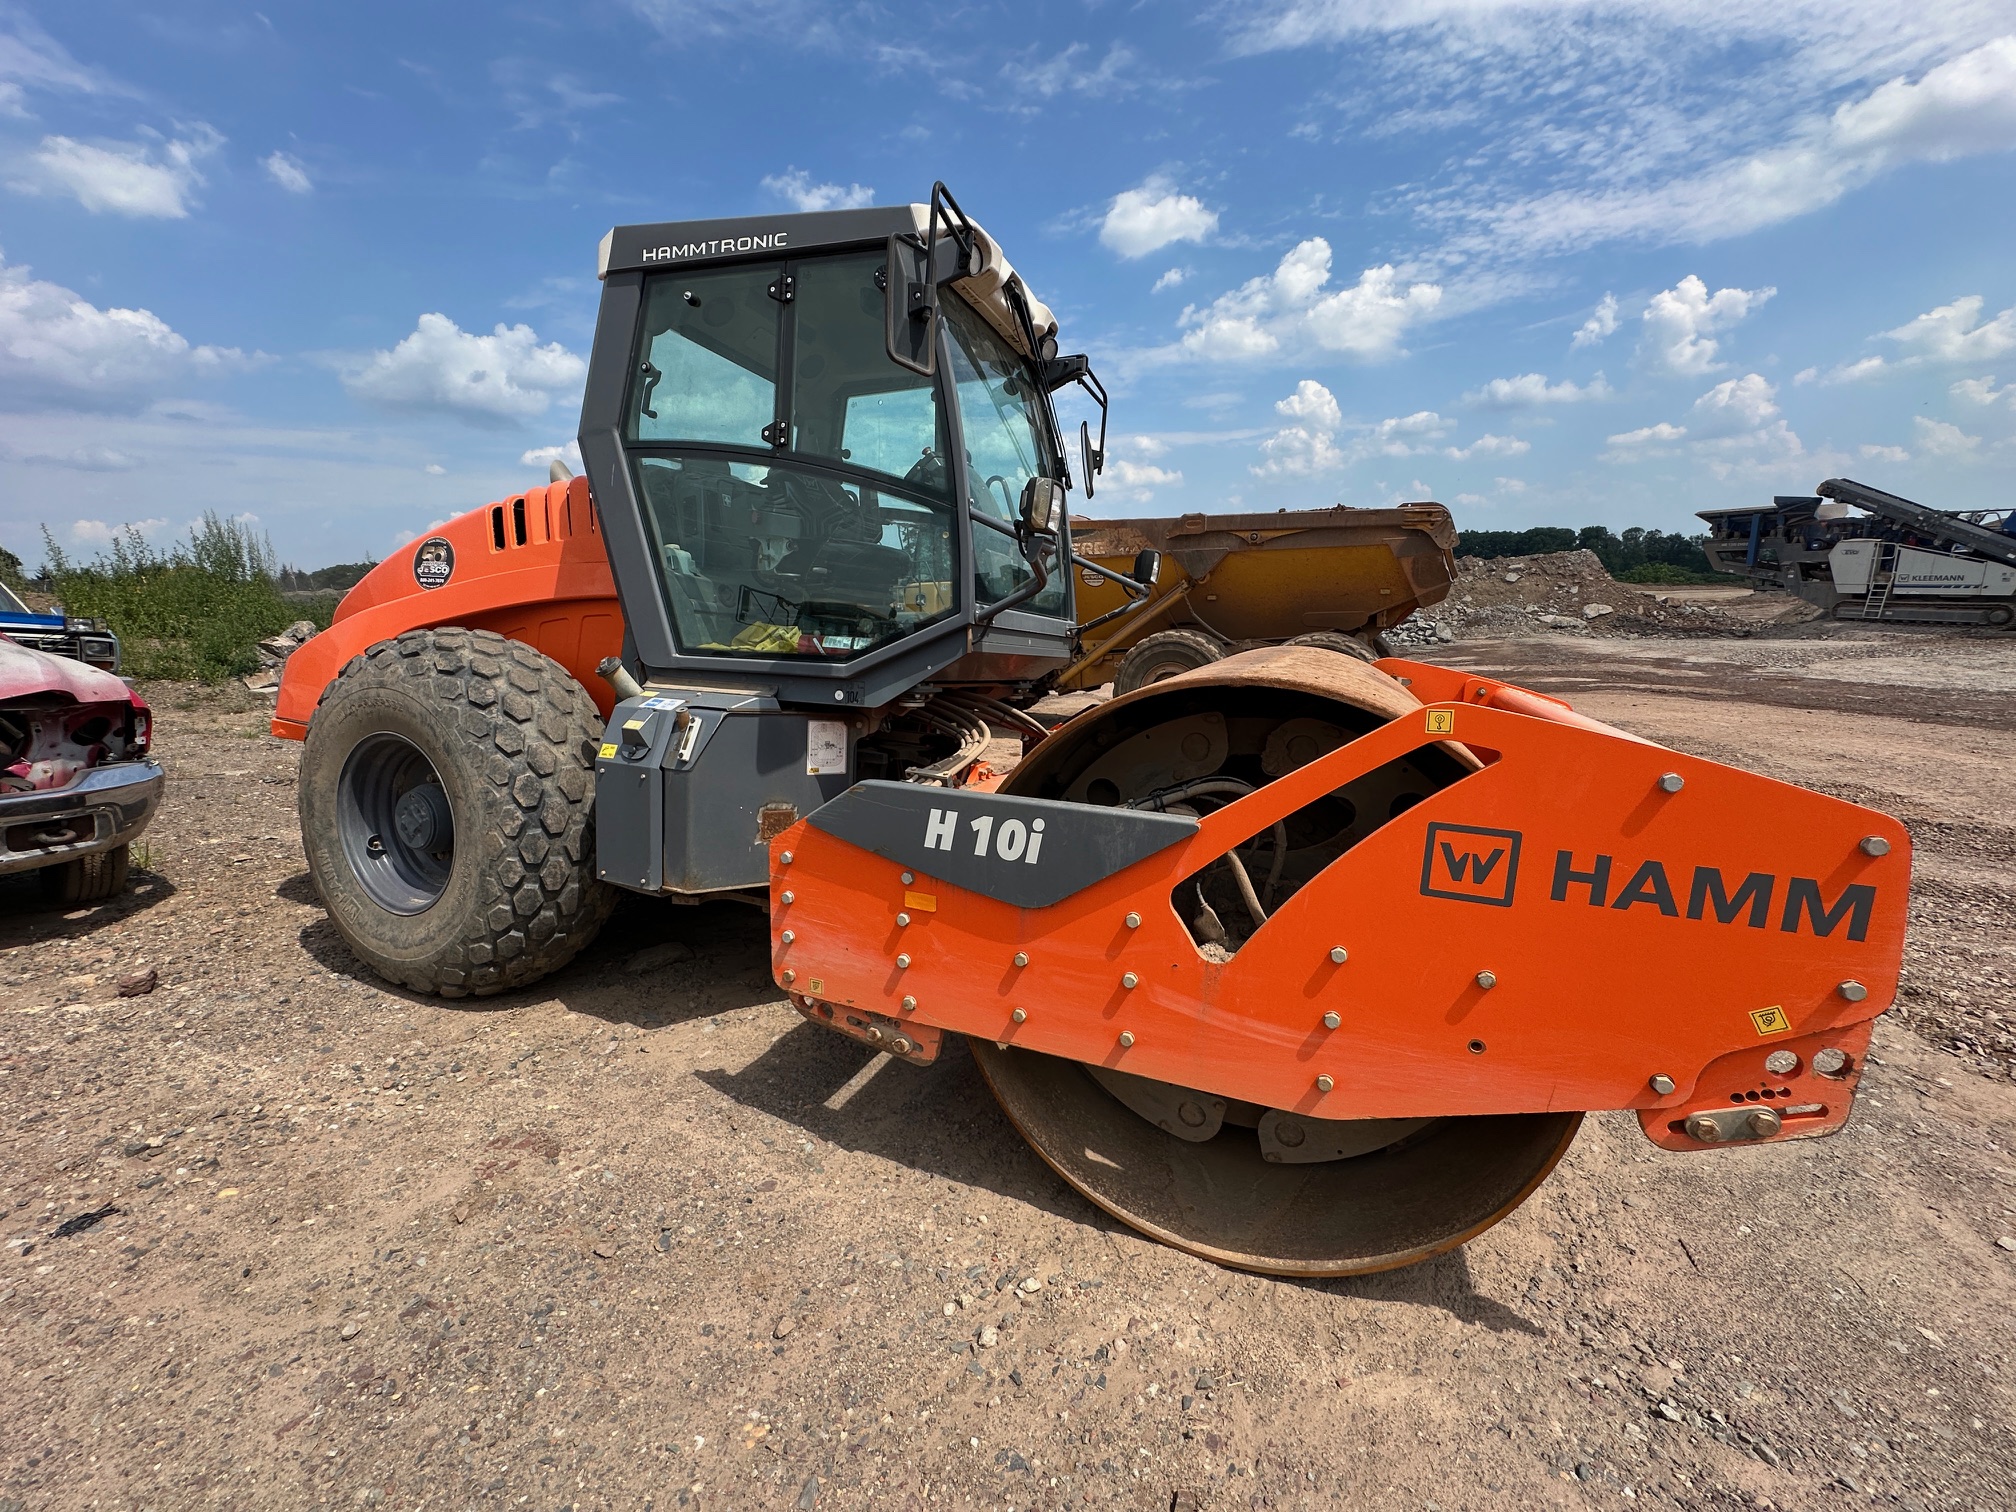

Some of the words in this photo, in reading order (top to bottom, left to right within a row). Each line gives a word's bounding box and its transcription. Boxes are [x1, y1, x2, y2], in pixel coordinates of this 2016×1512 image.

[642, 232, 788, 262] HAMMTRONIC
[417, 565, 449, 574] JESCO
[1911, 574, 1965, 582] KLEEMANN
[924, 808, 958, 851] H
[970, 815, 1046, 864] 10i
[1550, 849, 1877, 943] HAMM
